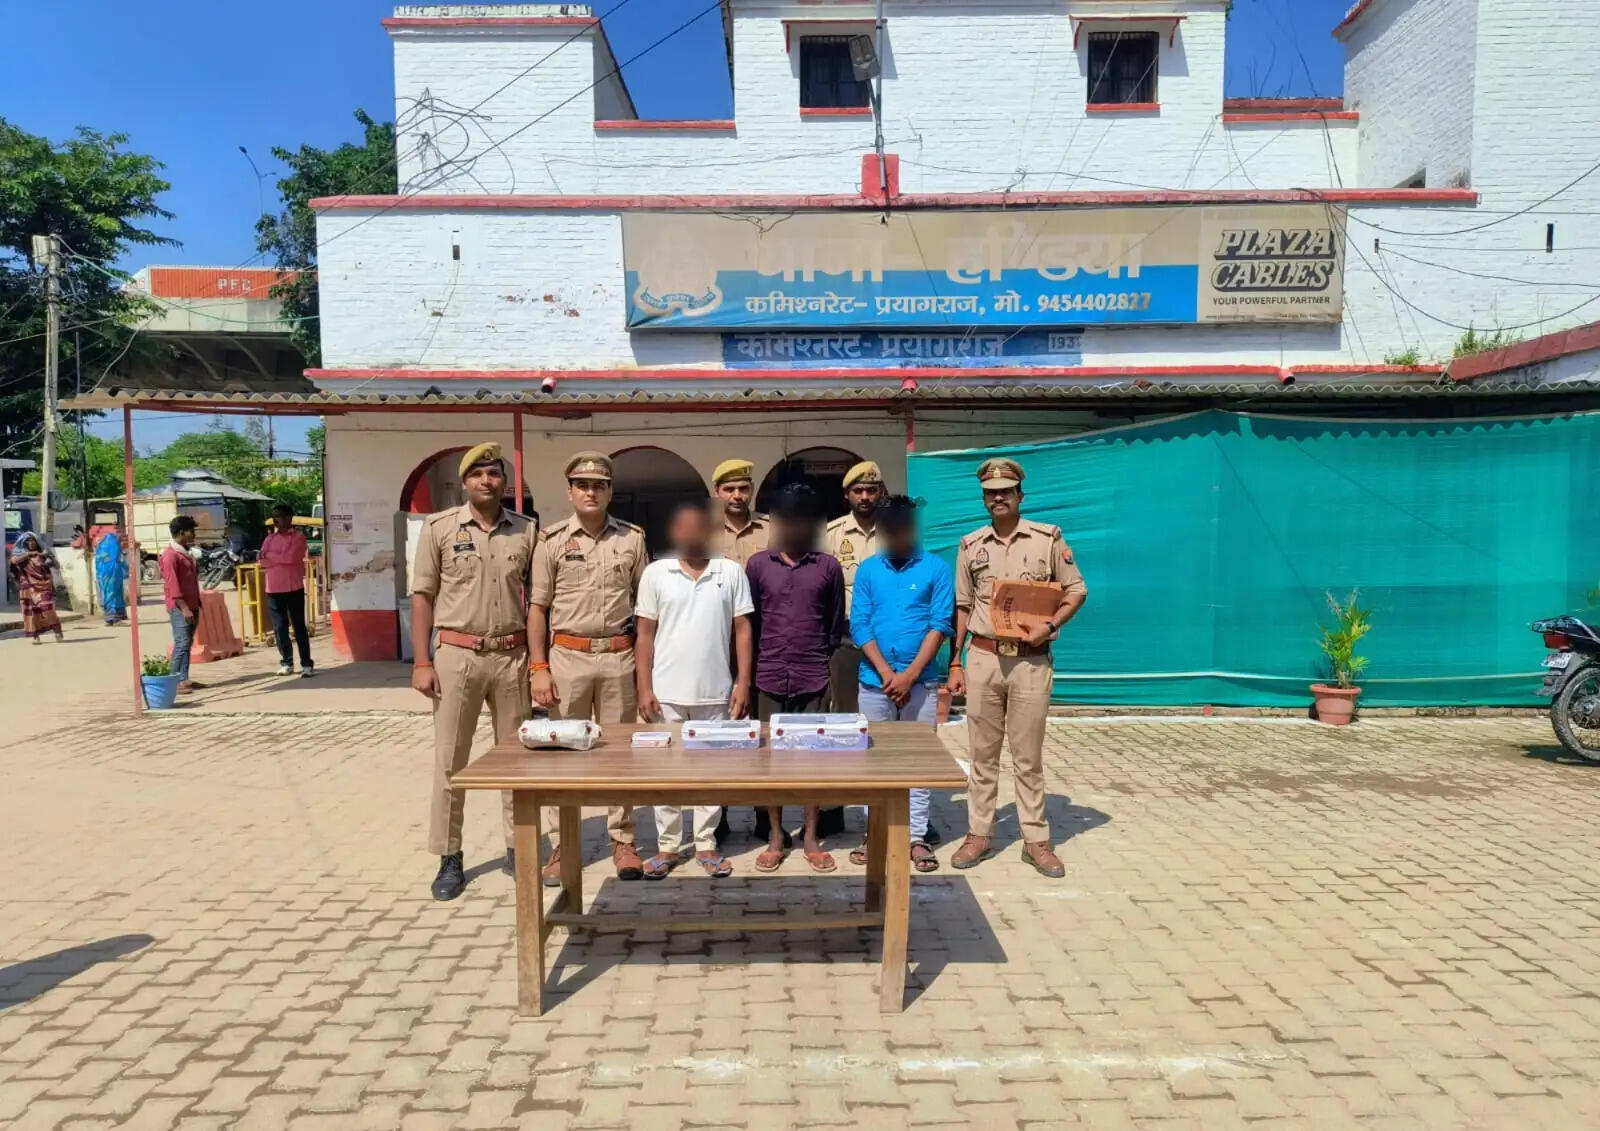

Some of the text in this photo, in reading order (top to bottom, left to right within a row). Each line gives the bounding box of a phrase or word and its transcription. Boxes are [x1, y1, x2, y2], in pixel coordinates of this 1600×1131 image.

[1214, 229, 1337, 260] PLAZA
[1211, 261, 1334, 292] CABLES
[875, 294, 986, 316] प्रयागराज,
[1212, 295, 1330, 305] YOUR POWERFUL PARTNER
